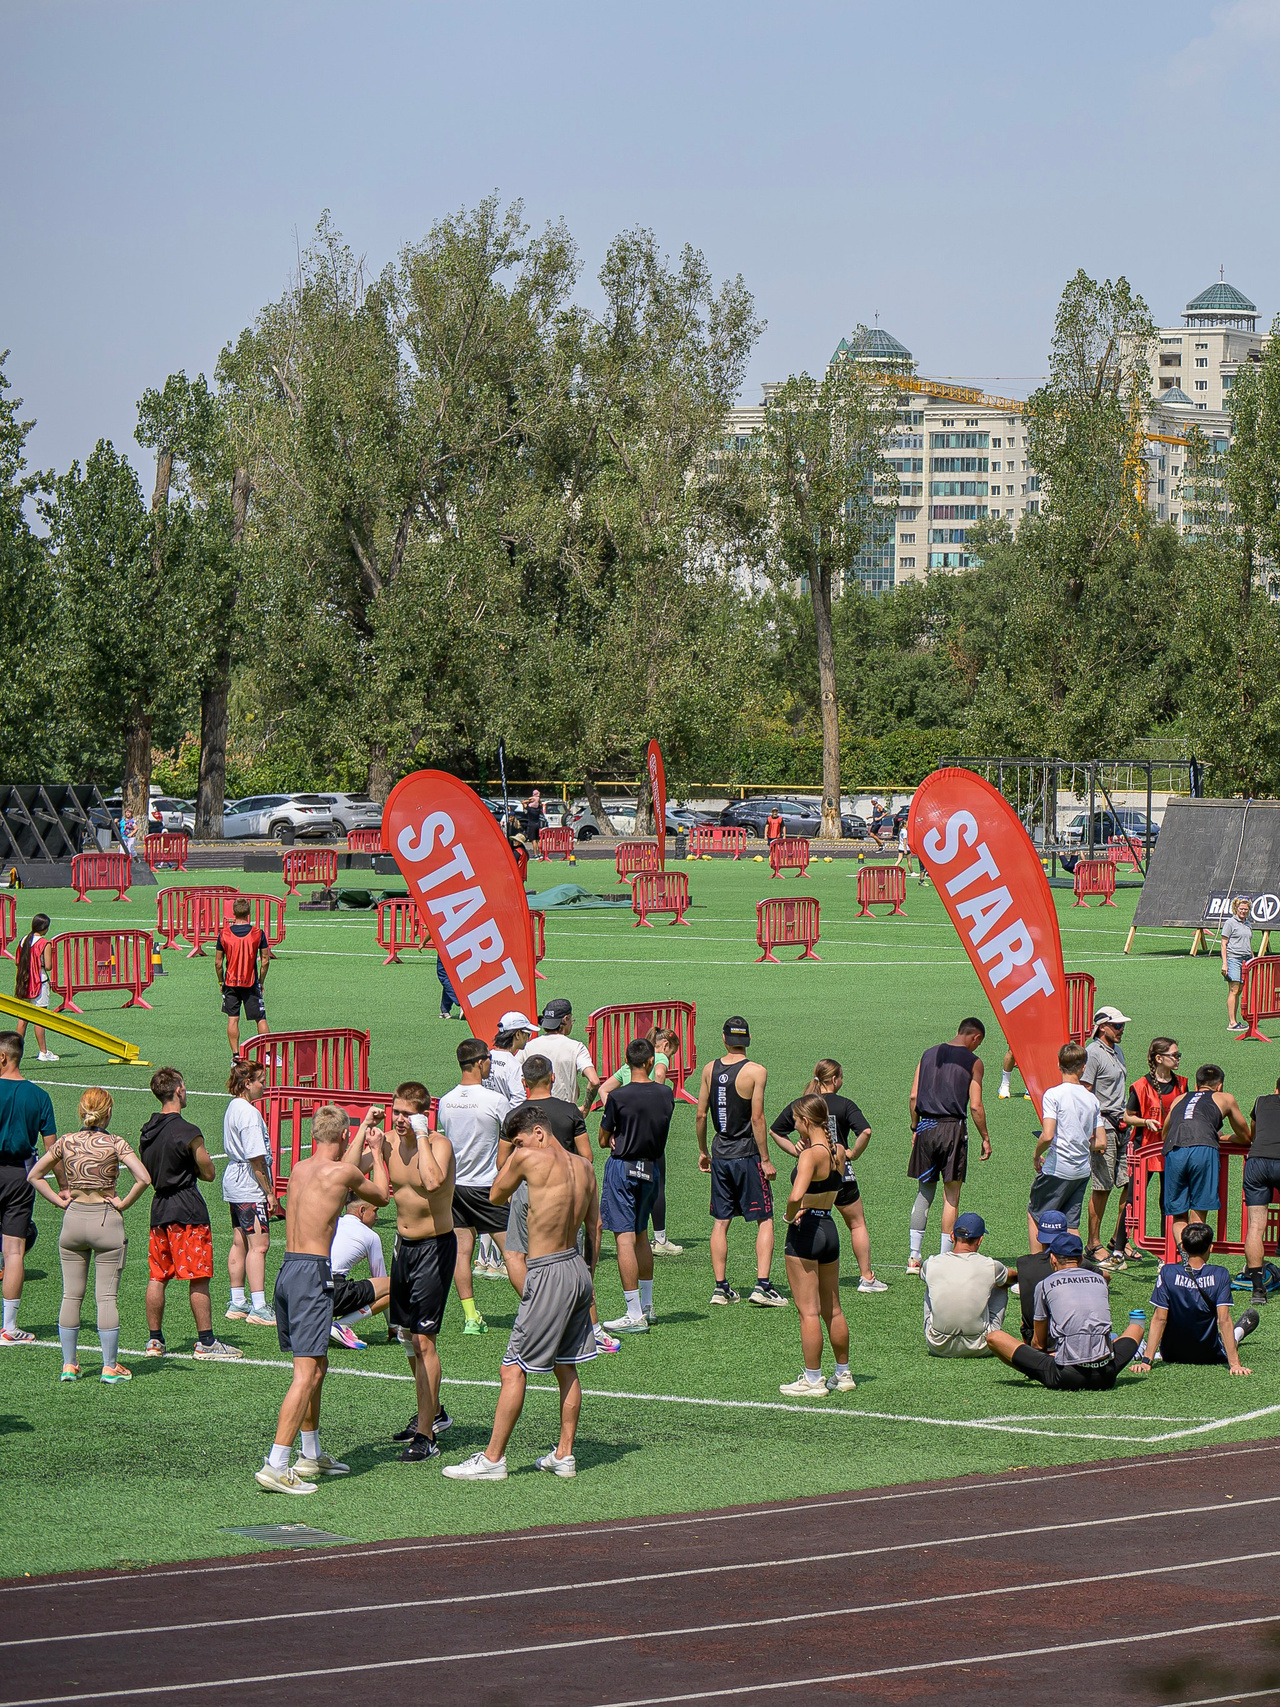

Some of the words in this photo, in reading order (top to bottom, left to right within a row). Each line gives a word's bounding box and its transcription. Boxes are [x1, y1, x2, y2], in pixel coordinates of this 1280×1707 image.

[397, 811, 525, 1008] START
[923, 809, 1055, 1015] START
[1208, 898, 1233, 914] RAC
[718, 1086, 726, 1106] RACE
[718, 1107, 728, 1133] NATION
[635, 1160, 645, 1171] 41
[1050, 1276, 1105, 1289] KAZAKHSTAN
[1174, 1273, 1215, 1289] KAZASTAN
